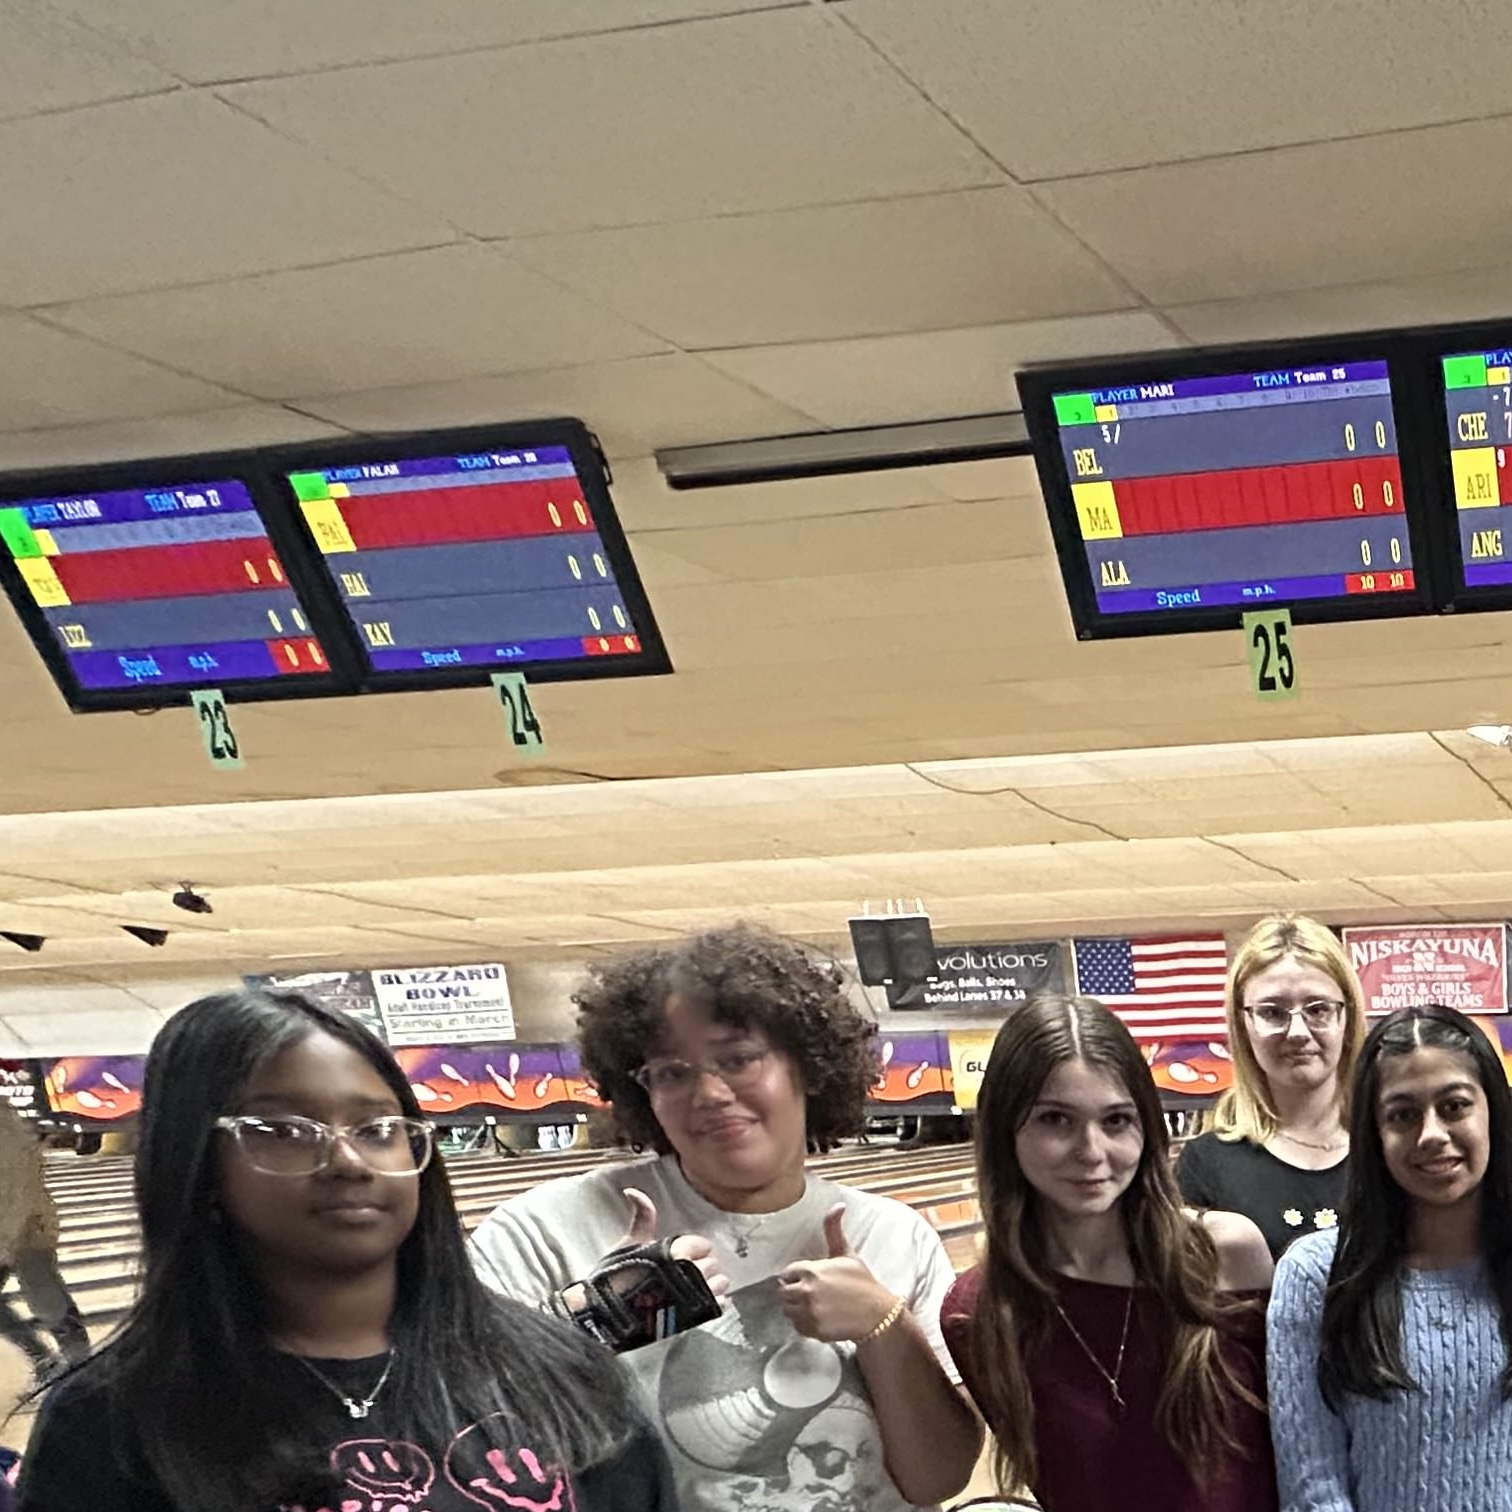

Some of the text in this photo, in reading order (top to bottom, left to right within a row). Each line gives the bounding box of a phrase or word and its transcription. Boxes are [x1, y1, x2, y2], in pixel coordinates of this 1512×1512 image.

[1092, 389, 1137, 403] PLAYER
[1140, 384, 1174, 398] MARI
[1254, 373, 1290, 387] TEAM
[1294, 371, 1326, 384] Team
[1457, 412, 1488, 441] CHE
[1504, 412, 1512, 438] 7
[457, 456, 490, 469] TEAM
[491, 454, 520, 466] Team
[1073, 421, 1386, 476] BEL 0 0
[1353, 482, 1363, 509] 0
[1383, 480, 1393, 507] 0
[1465, 474, 1492, 500] ARI
[1471, 530, 1502, 557] ANG
[567, 555, 582, 580] 0
[593, 553, 607, 577] 0
[1101, 538, 1401, 586] ALA 0 0
[1156, 573, 1404, 607] Speed m.p.h. 10 10
[588, 607, 602, 631] 0
[612, 605, 626, 629] 0
[118, 656, 162, 682] Speed
[421, 650, 462, 667] Speed
[1253, 621, 1294, 692] 25
[501, 683, 543, 745] 24
[200, 700, 238, 759] 23
[937, 952, 1048, 971] volutions
[1350, 938, 1500, 970] NISKAYUNA
[380, 967, 499, 985] BLIZZARD
[986, 976, 1016, 987] Shoes
[1381, 982, 1472, 996] BOYS & GIRLS
[406, 986, 480, 1000] BOWL
[924, 992, 959, 1003] Behind
[960, 991, 988, 1001] Lanes
[989, 990, 1003, 1001] 37
[1004, 990, 1012, 1000] &
[1371, 995, 1483, 1009] BOWLING TEAMS
[389, 1018, 443, 1029] Starting
[465, 1014, 509, 1025] March
